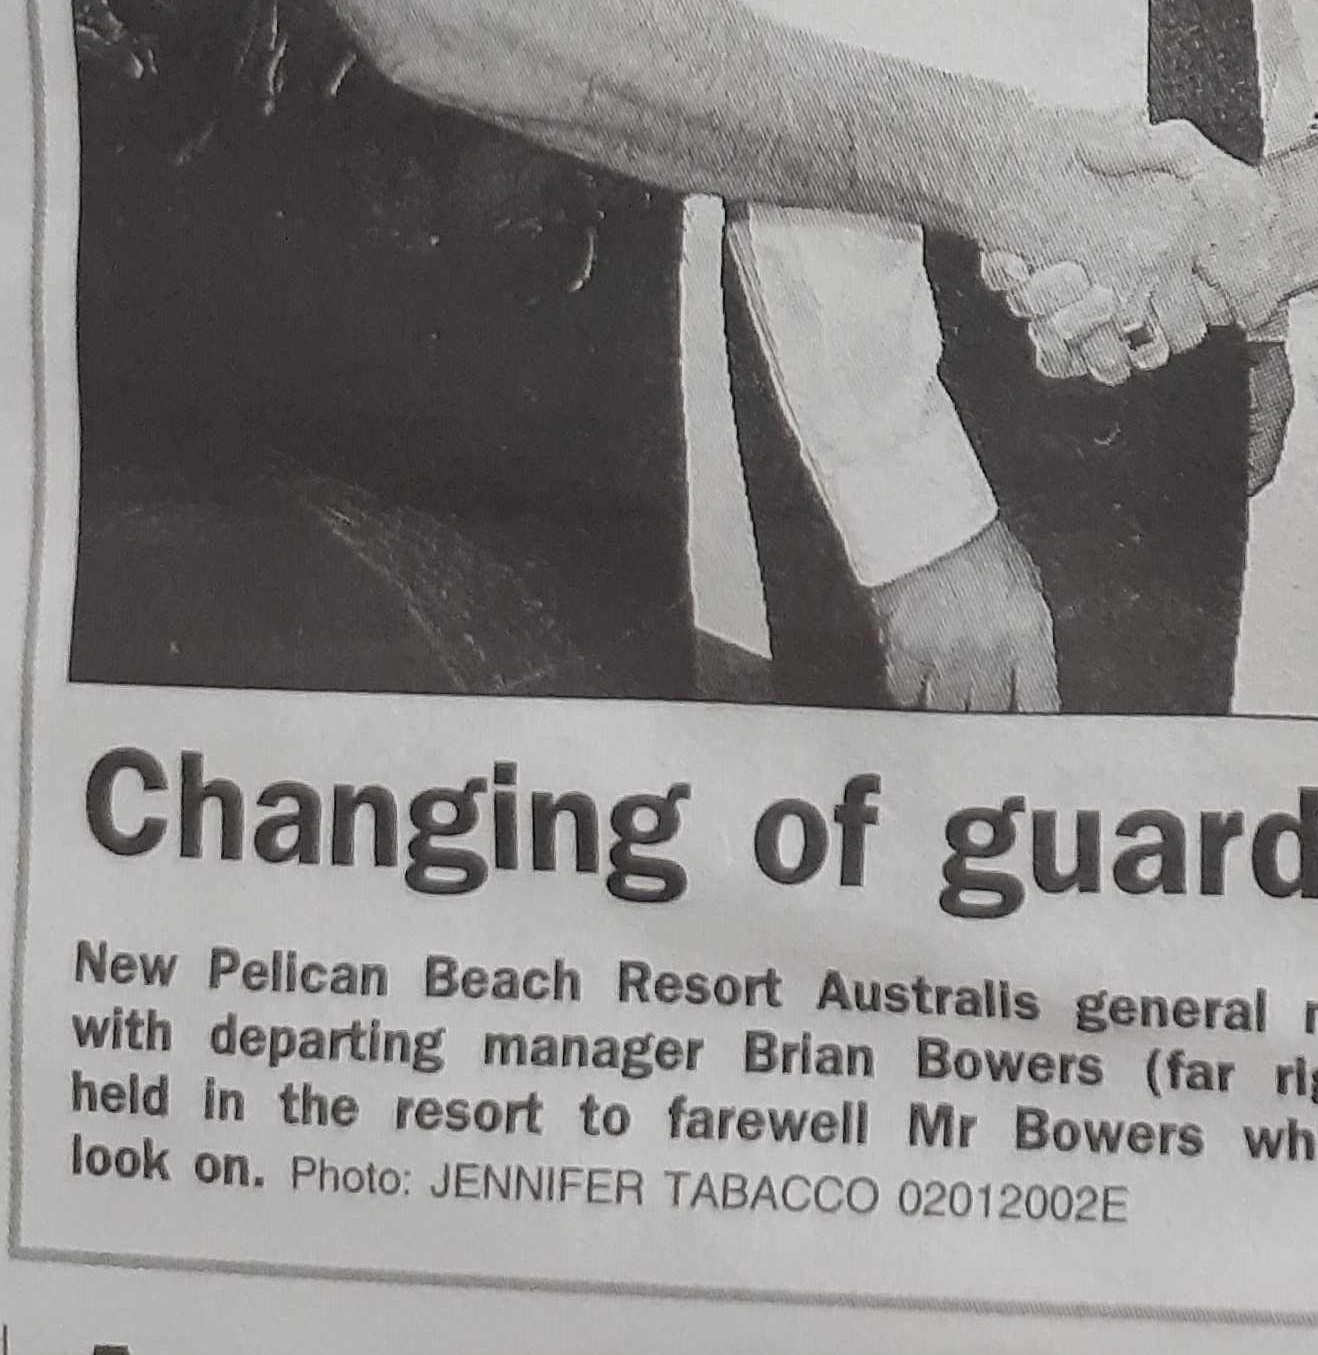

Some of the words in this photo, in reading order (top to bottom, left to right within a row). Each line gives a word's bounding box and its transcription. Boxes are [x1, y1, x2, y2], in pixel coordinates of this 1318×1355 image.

[85, 747, 691, 904] Changing
[754, 773, 881, 887] of
[75, 940, 178, 987] New
[209, 947, 387, 996] Pelican
[425, 955, 580, 1002] Beach
[618, 960, 783, 1008] Resort
[816, 969, 1040, 1020] Australis
[1076, 988, 1266, 1033] general
[72, 1006, 171, 1051] with
[210, 1012, 446, 1074] departing
[484, 1032, 704, 1080] manager
[744, 1030, 874, 1077] Brian
[918, 1036, 1103, 1086] Bowers
[1146, 1048, 1235, 1099] (far
[72, 1070, 169, 1117] held
[204, 1076, 244, 1121] in
[278, 1082, 359, 1127] the
[395, 1092, 543, 1136] resort
[579, 1093, 630, 1138] to
[668, 1094, 868, 1146] farewell
[909, 1102, 977, 1149] Mr
[1015, 1105, 1204, 1158] Bowers
[72, 1133, 171, 1181] look
[195, 1153, 264, 1188] on.
[292, 1156, 411, 1196] Photo:
[430, 1163, 643, 1205] JENNIFER
[664, 1170, 879, 1215] TABACCO
[899, 1180, 1127, 1223] 02012002E
